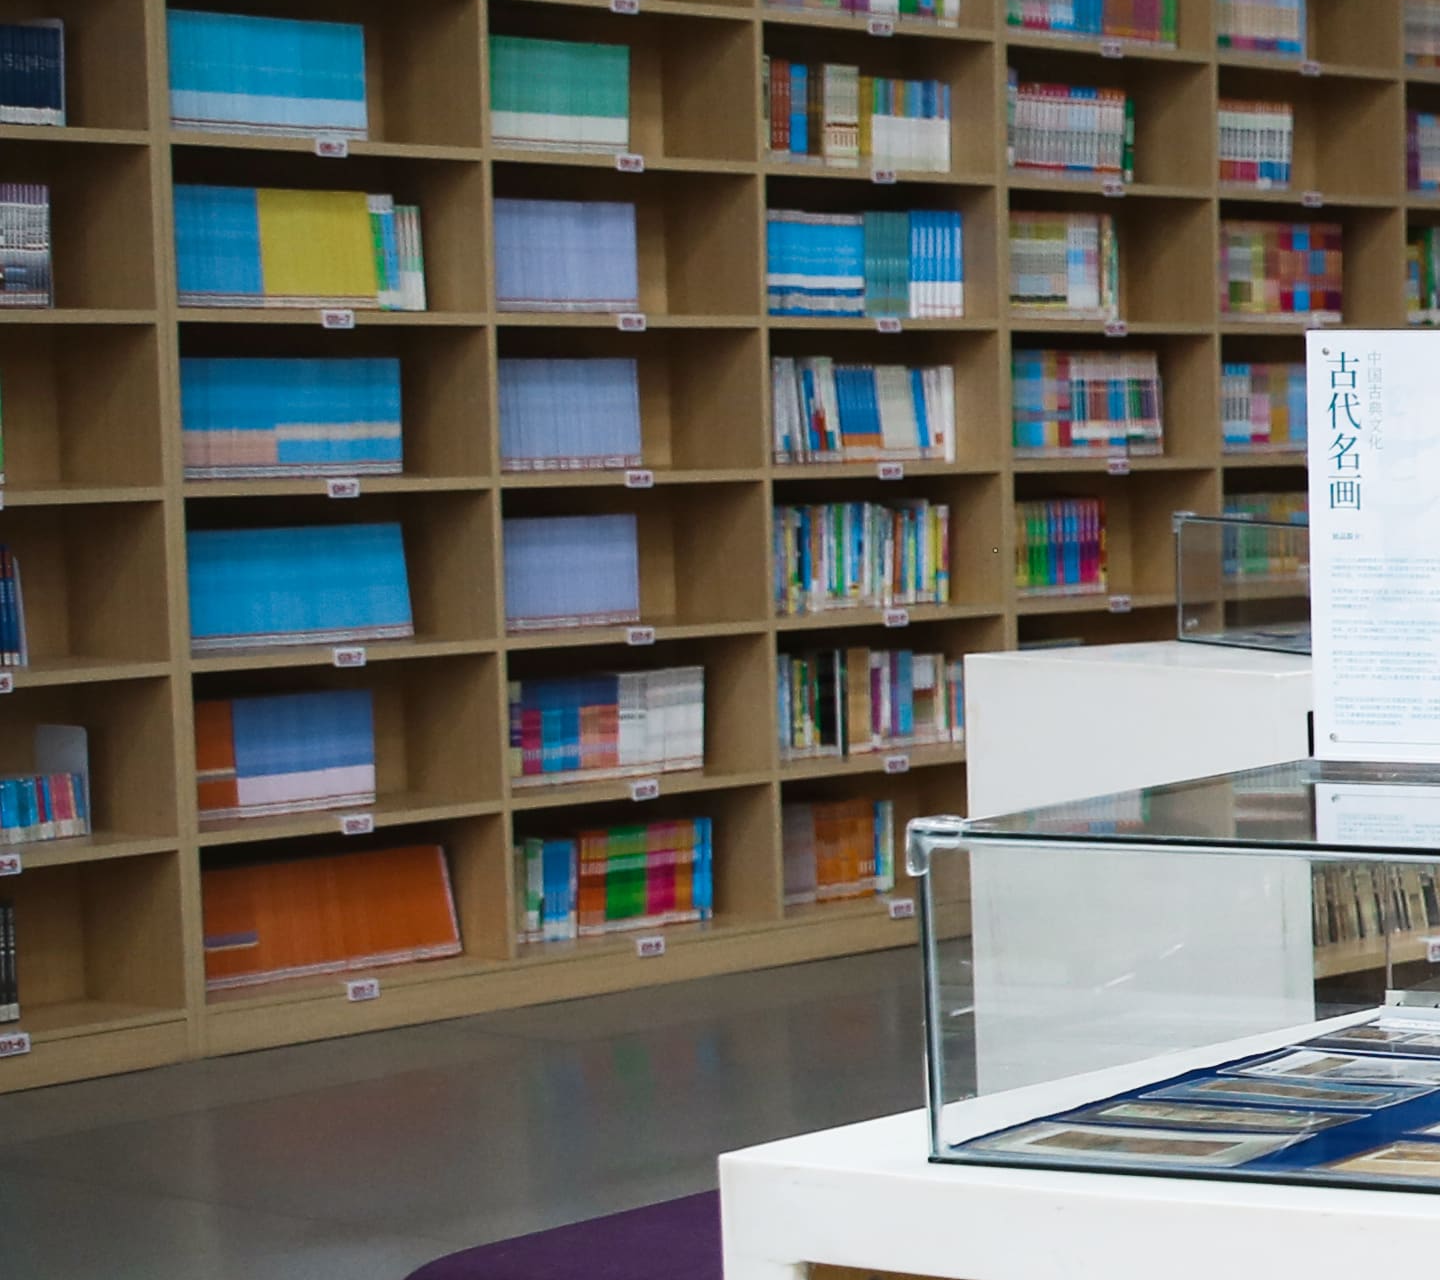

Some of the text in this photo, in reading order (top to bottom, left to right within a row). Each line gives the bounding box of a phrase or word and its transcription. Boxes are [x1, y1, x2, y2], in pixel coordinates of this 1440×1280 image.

[1326, 351, 1362, 511] 古代名画
[1367, 350, 1384, 451] 中国古典文化
